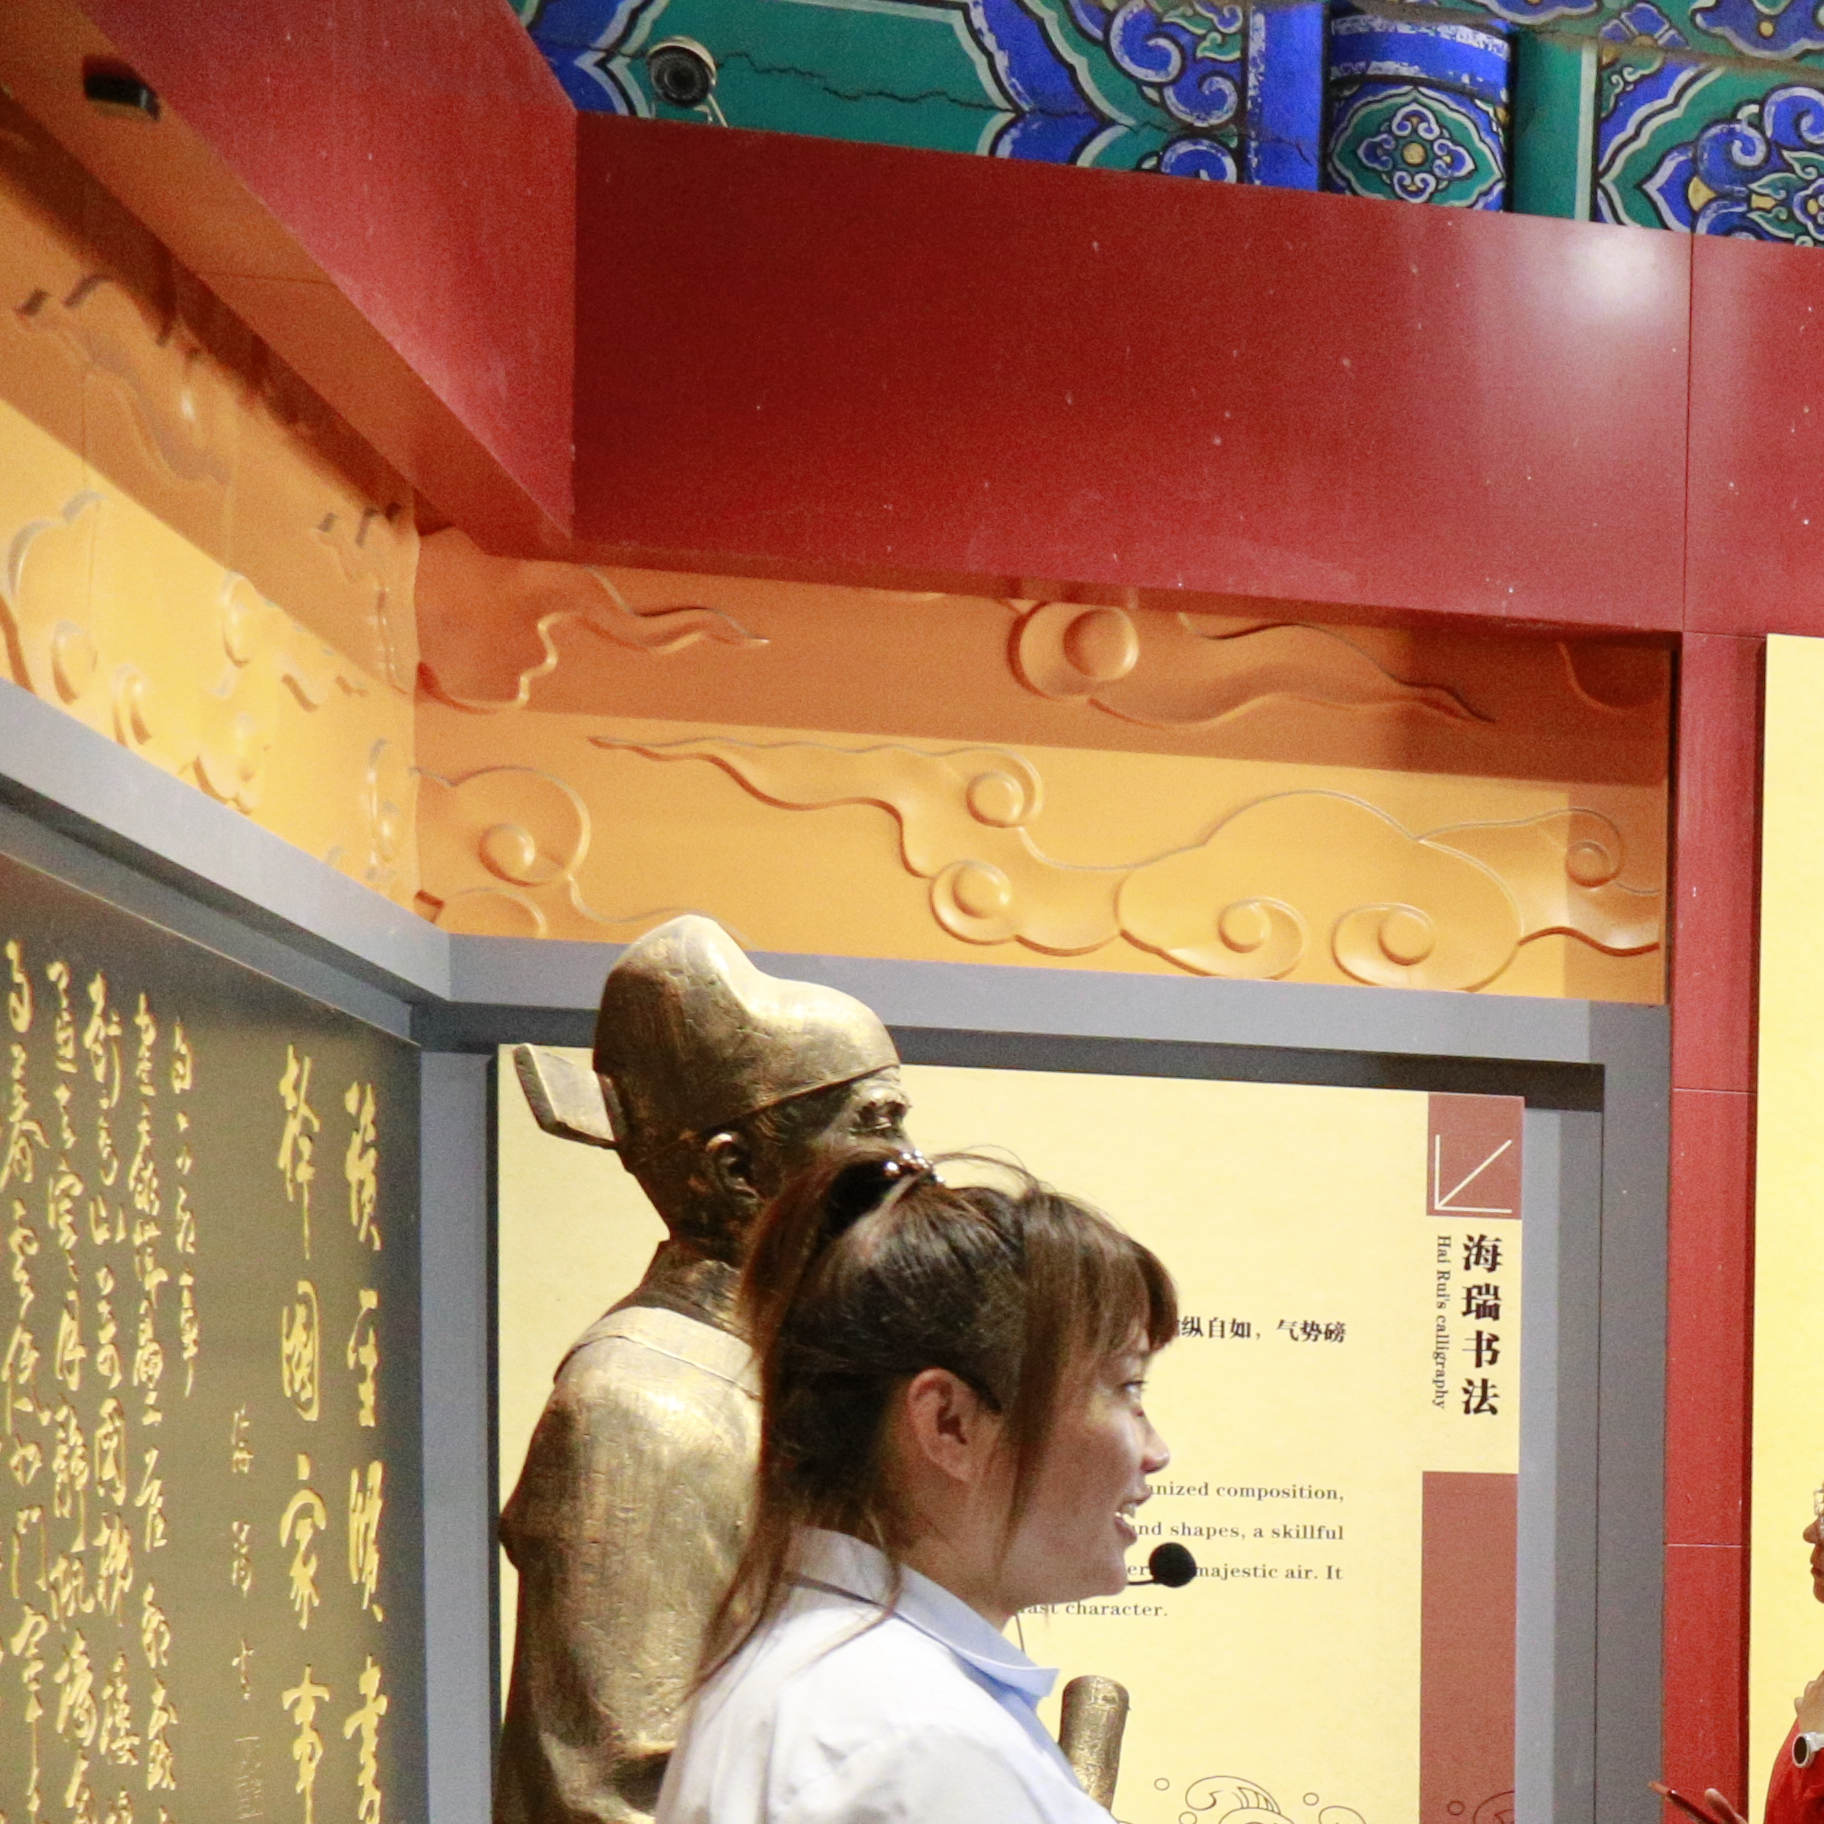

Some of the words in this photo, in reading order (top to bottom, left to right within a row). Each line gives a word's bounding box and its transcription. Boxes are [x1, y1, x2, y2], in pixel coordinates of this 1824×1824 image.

[1436, 1235, 1451, 1263] Hai
[1436, 1270, 1451, 1309] Rui's
[1178, 1315, 1347, 1344] 纵自如，气势磅
[1462, 1233, 1502, 1416] 海瑞书法
[1432, 1314, 1451, 1409] calligraphy
[1148, 1480, 1209, 1498] nized
[1170, 1522, 1246, 1542] shapes,
[1252, 1527, 1266, 1540] a
[1271, 1523, 1344, 1541] skillful
[1325, 1564, 1343, 1581] It
